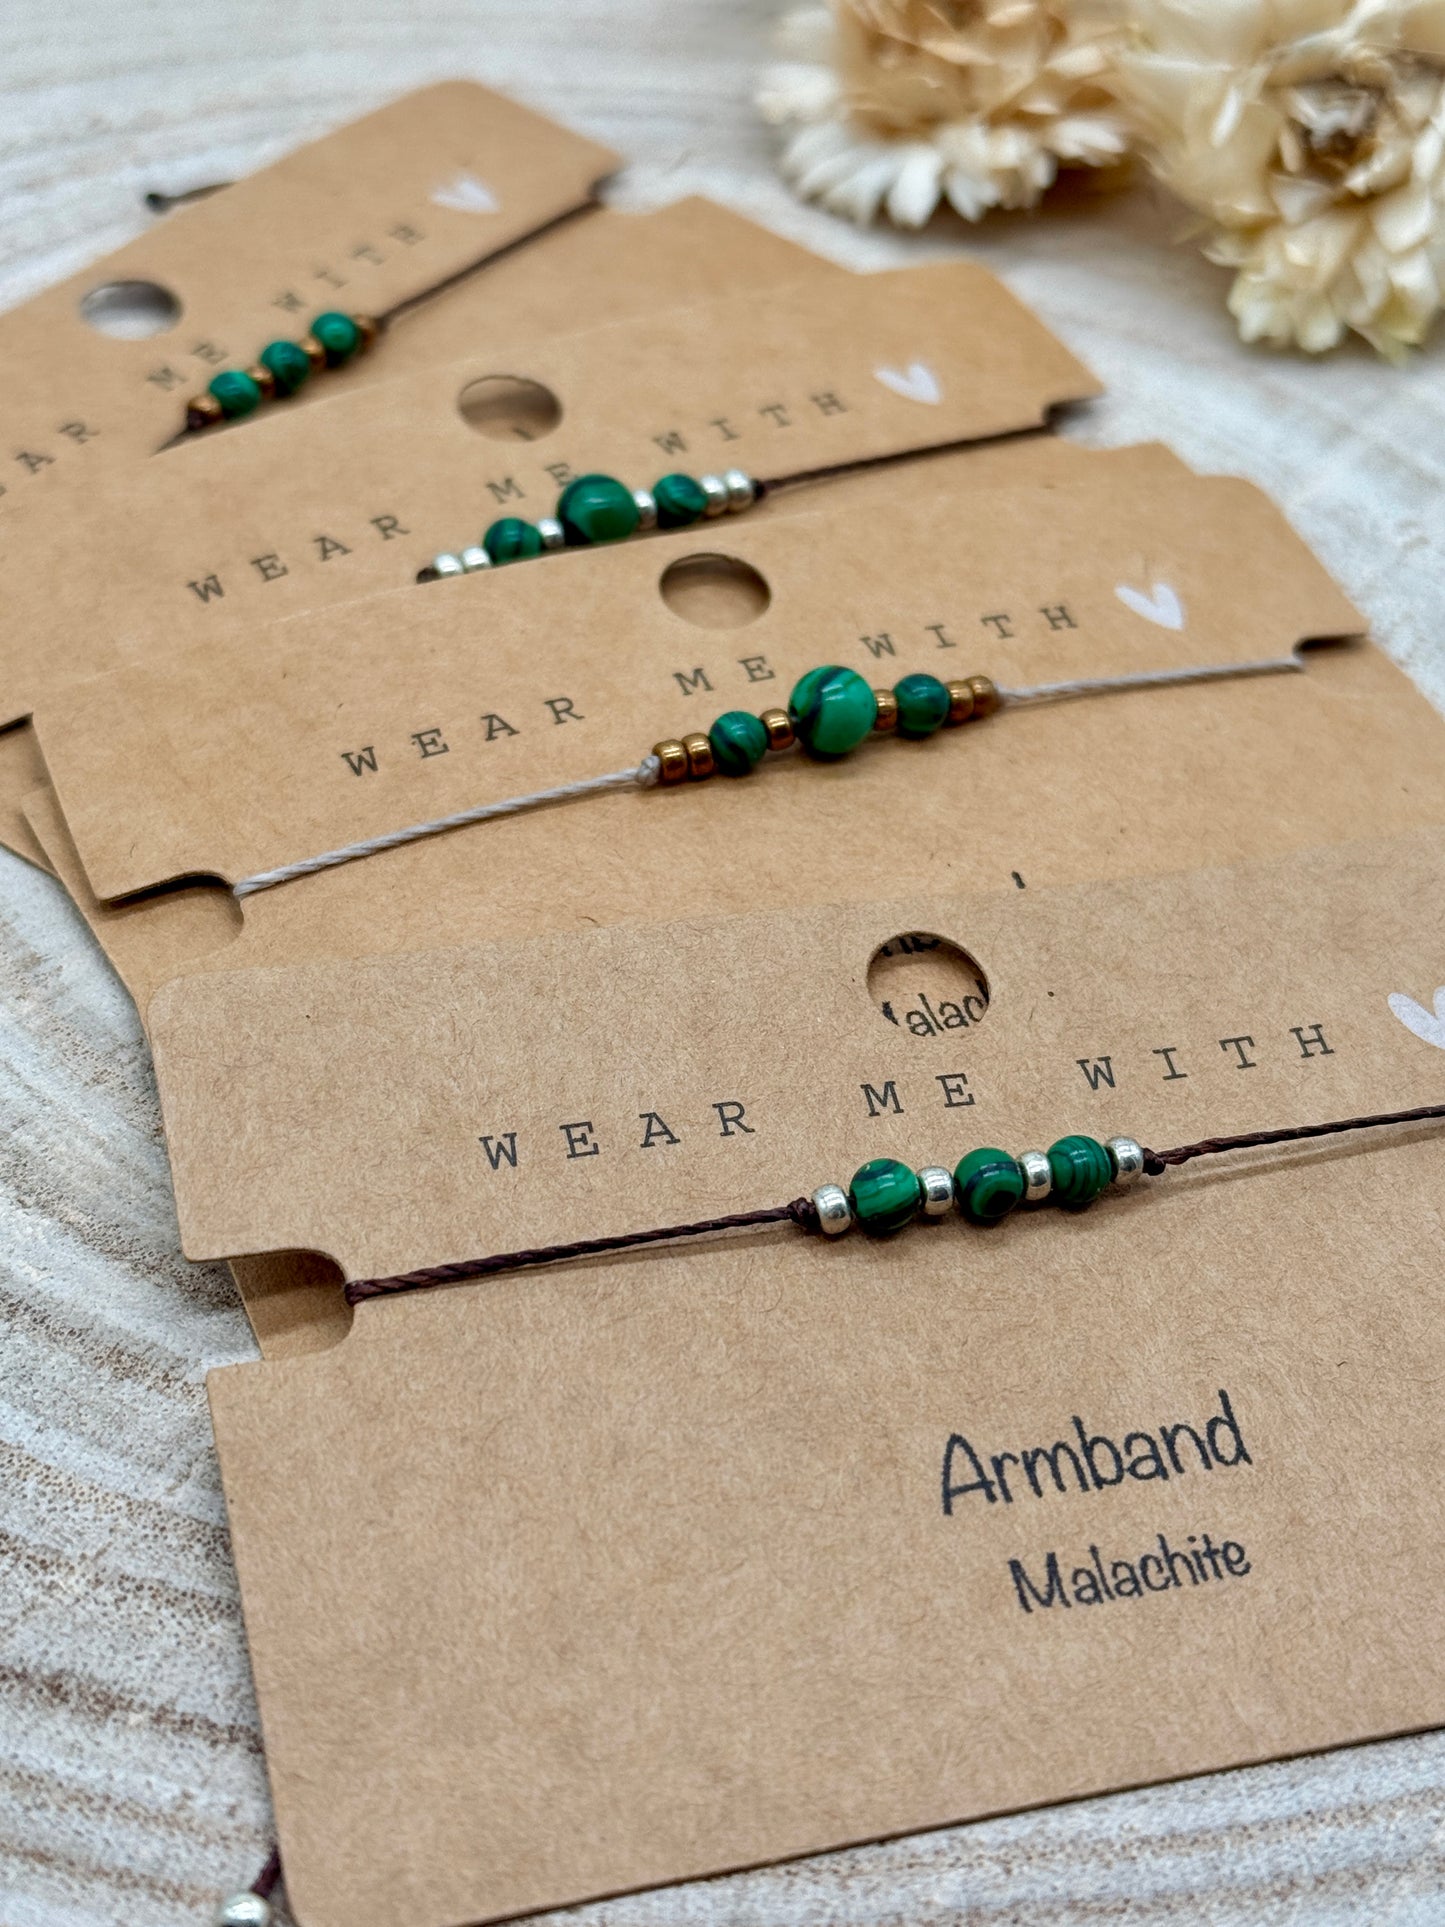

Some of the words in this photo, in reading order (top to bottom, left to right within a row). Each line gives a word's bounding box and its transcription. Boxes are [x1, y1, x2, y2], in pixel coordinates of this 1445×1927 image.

[0, 418, 99, 497] AR
[186, 514, 411, 603] WEAR
[486, 461, 577, 505] ME
[653, 392, 848, 455] WITH
[340, 697, 585, 777] WEAR
[672, 655, 775, 696] ME
[860, 605, 1078, 659] WITH
[881, 979, 990, 1037] alac
[478, 1101, 756, 1170] WEAR
[860, 1073, 975, 1118] ME
[1076, 1023, 1334, 1091] WITH
[942, 1388, 1253, 1516] Armband
[1007, 1533, 1252, 1614] Malachite
